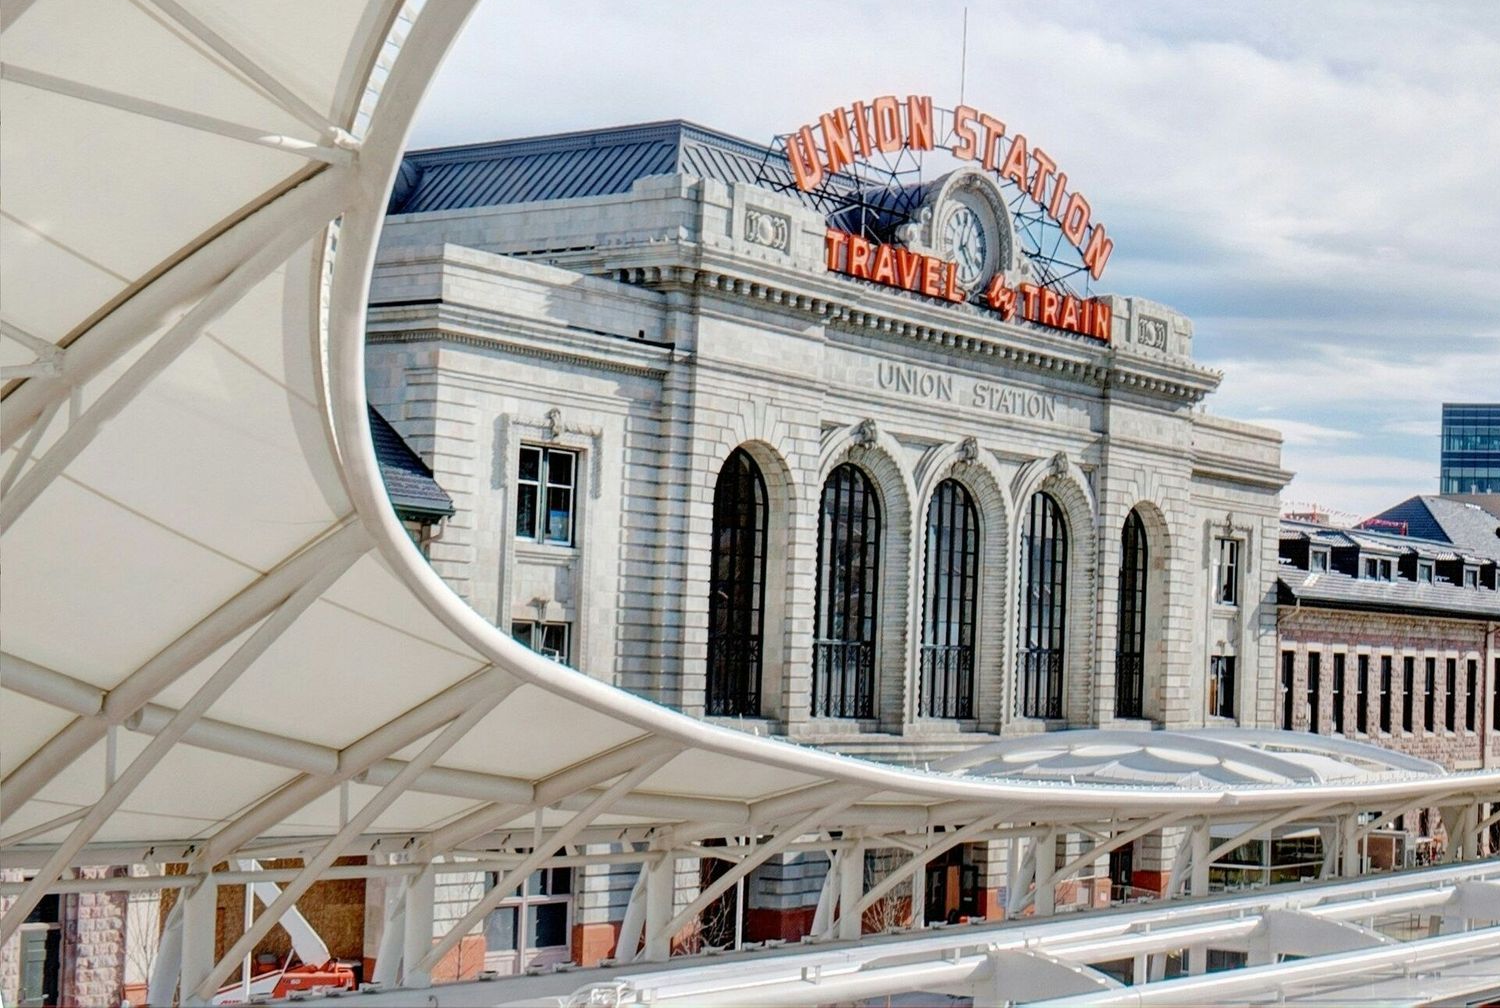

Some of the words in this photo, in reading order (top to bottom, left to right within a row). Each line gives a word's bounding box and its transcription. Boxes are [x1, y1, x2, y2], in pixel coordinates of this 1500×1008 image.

[787, 95, 934, 191] UNION
[953, 105, 1113, 280] STATION
[826, 228, 966, 304] TRAVEL
[987, 273, 1017, 321] by
[1020, 283, 1112, 340] TRAIN
[878, 362, 952, 401] UNION
[972, 383, 1055, 421] STATION
